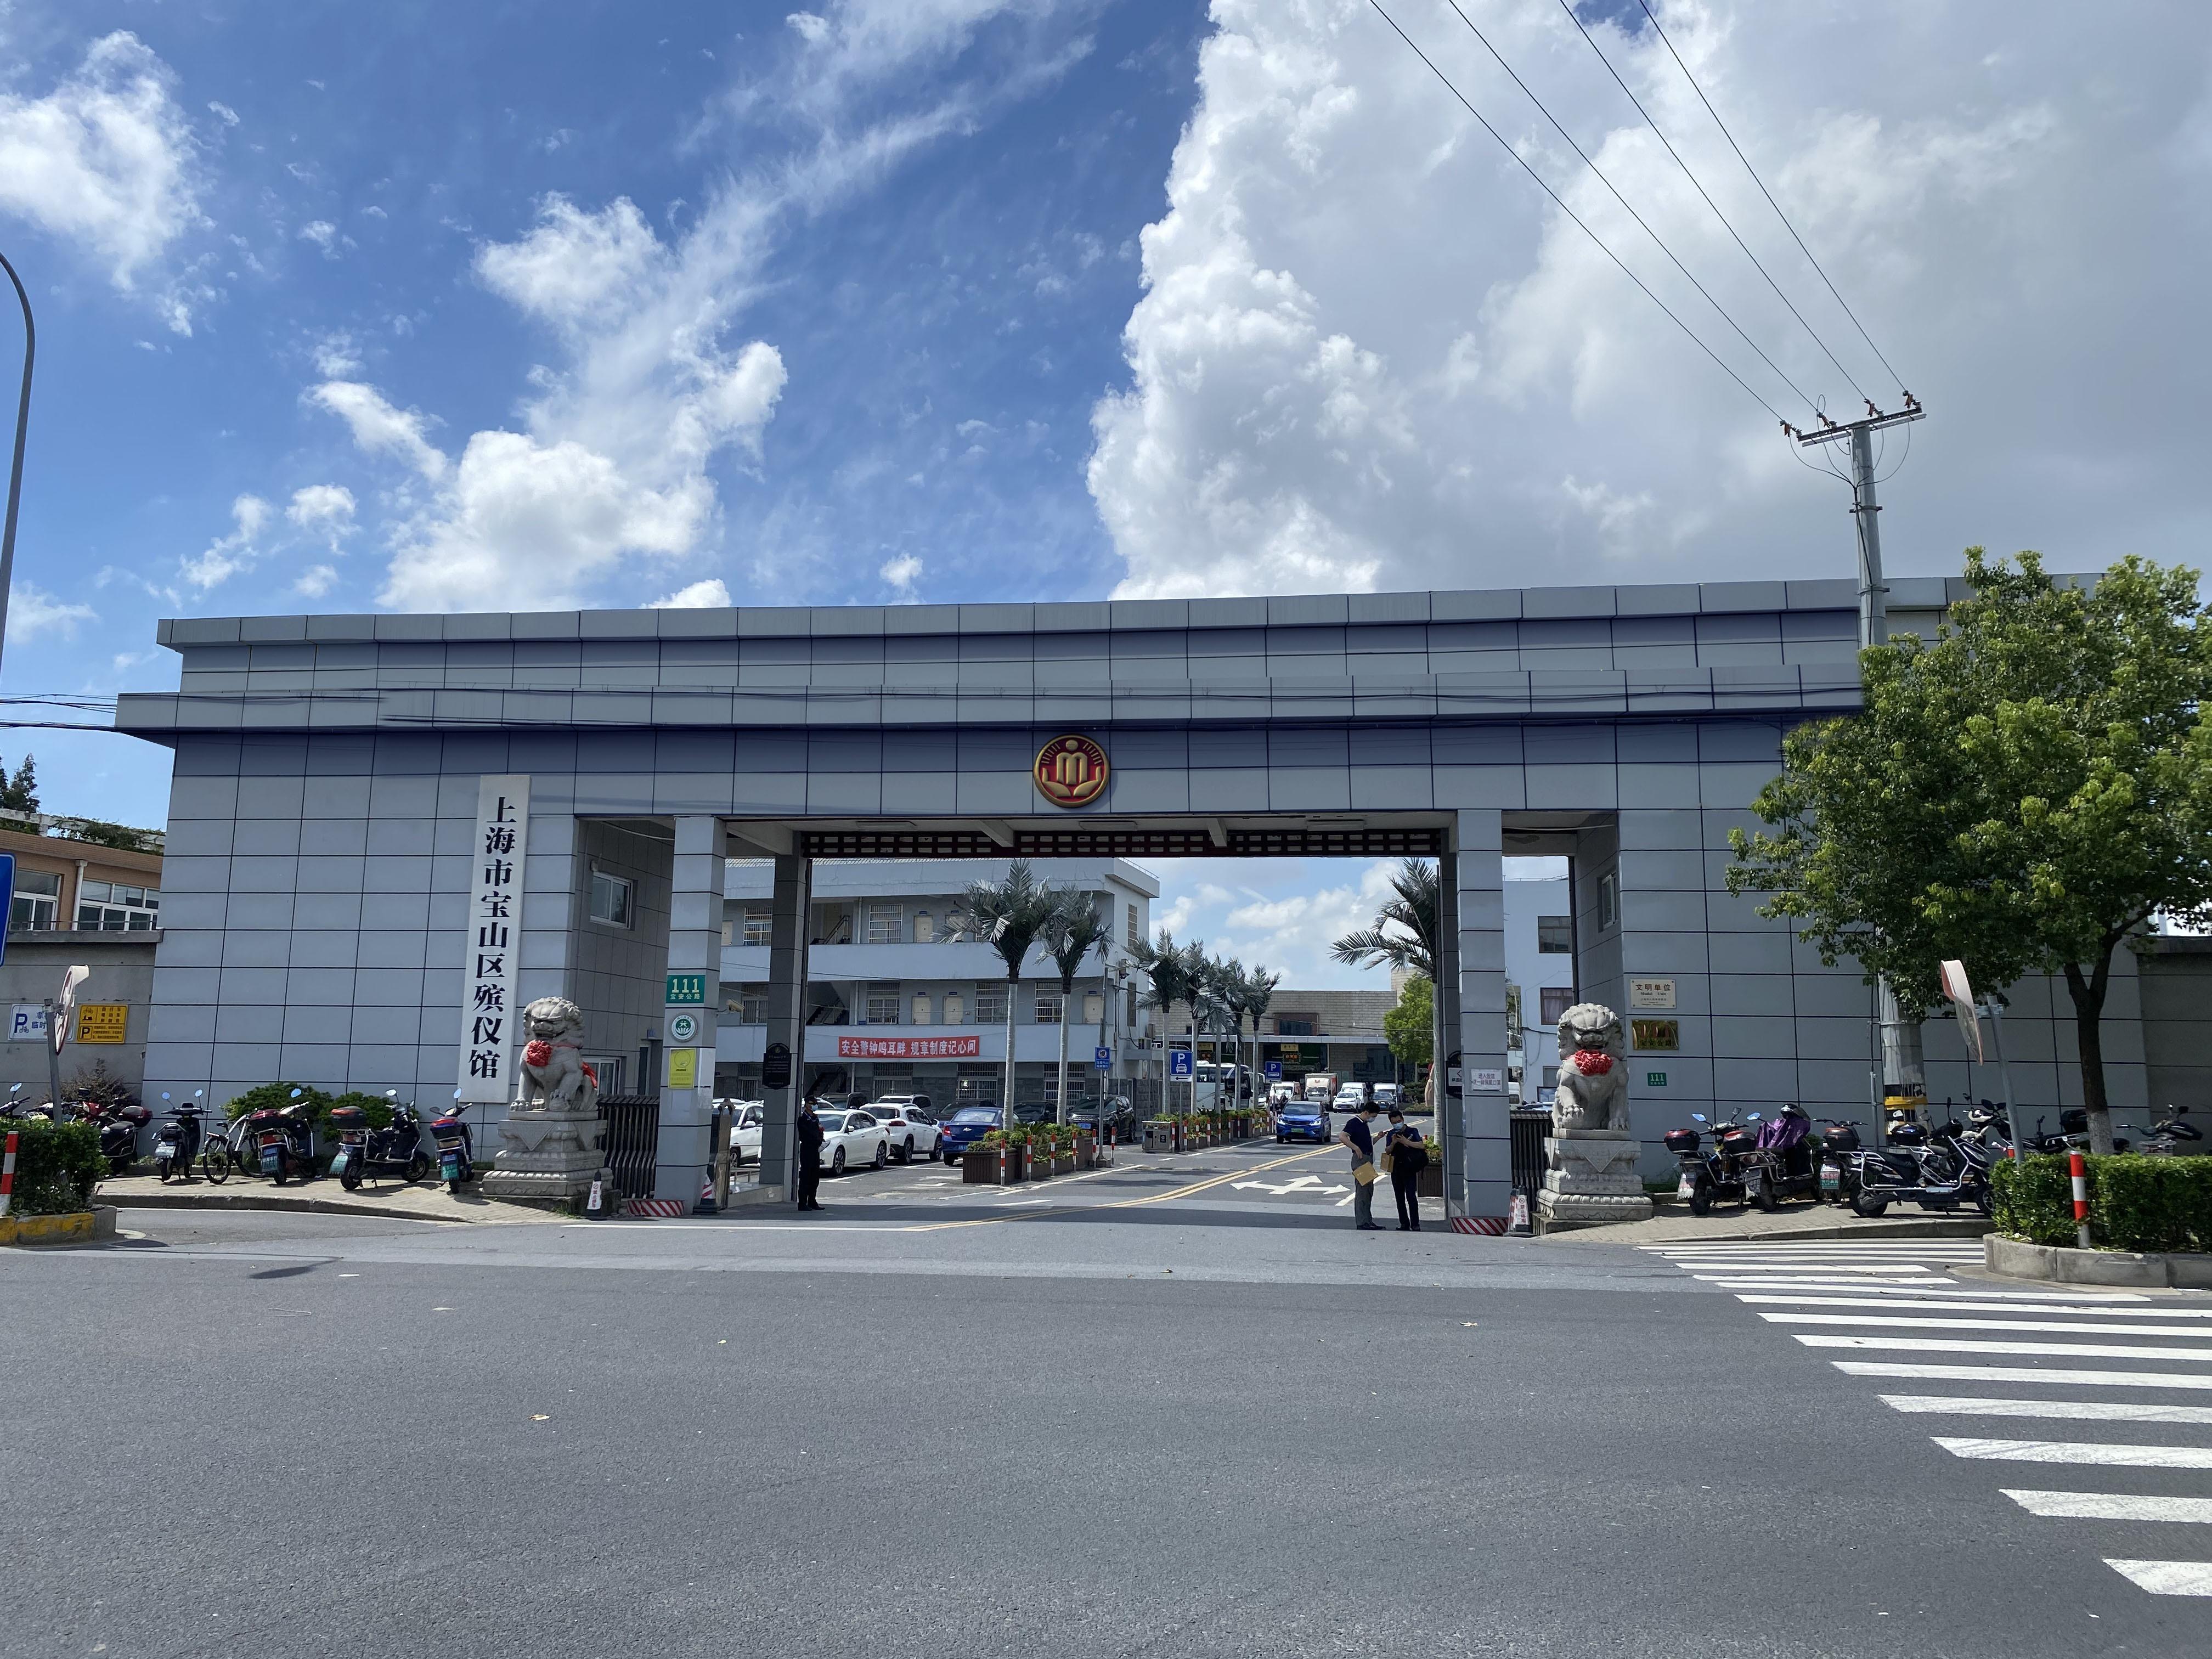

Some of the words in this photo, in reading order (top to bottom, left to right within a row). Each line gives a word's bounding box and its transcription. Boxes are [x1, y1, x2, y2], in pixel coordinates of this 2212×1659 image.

[469, 796, 517, 1079] 上海市宝山区殡仪馆
[672, 978, 699, 993] 111
[14, 1013, 27, 1034] P
[81, 1026, 91, 1038] P
[842, 1040, 906, 1056] 安全警钟鸣耳畔
[911, 1039, 976, 1056] 规章制度记心间
[1178, 1053, 1186, 1063] P
